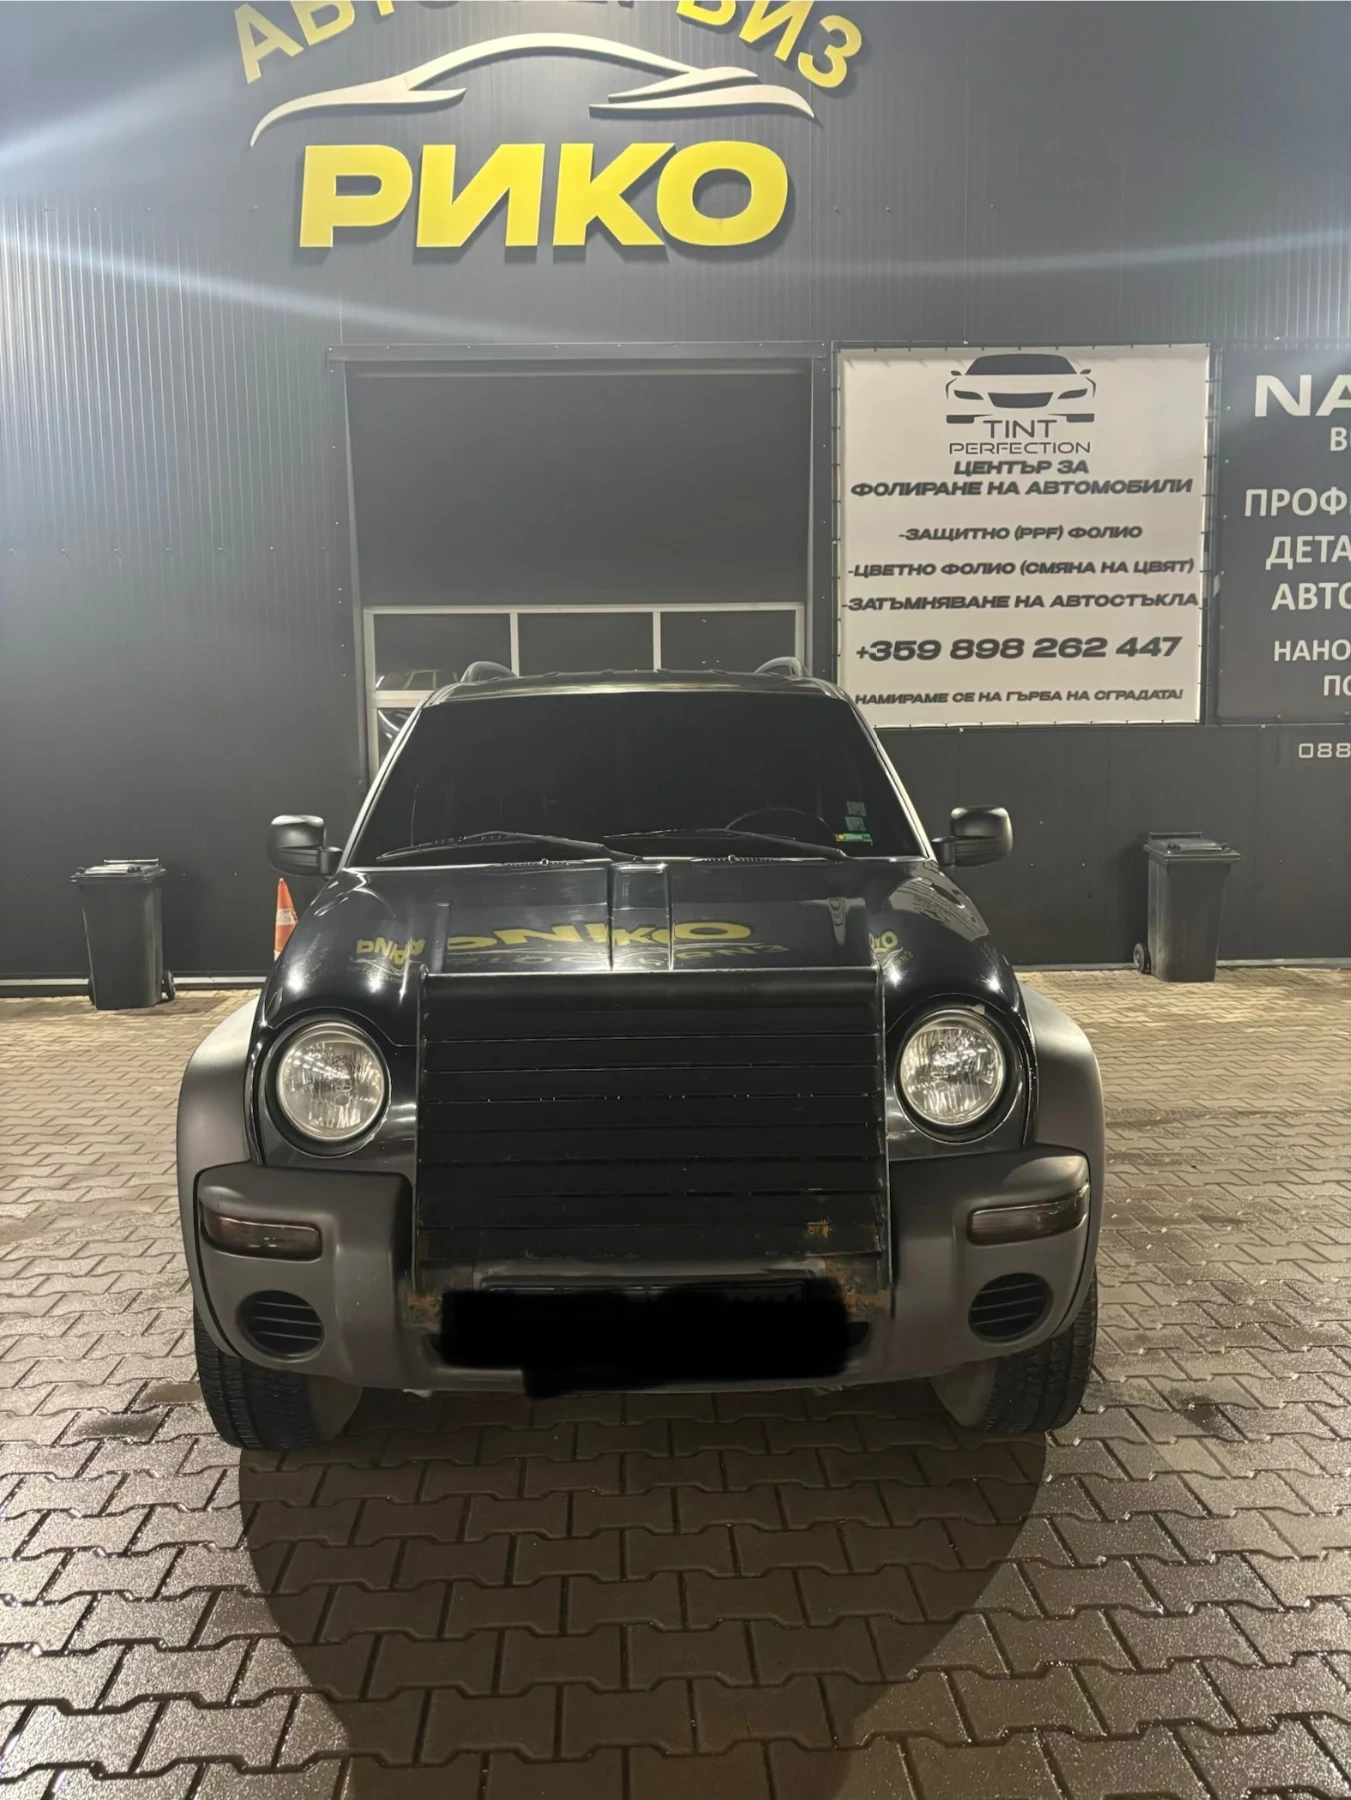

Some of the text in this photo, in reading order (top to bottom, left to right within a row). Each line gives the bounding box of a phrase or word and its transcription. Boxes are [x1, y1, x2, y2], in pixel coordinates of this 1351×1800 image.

[299, 140, 788, 248] РИКО
[982, 419, 1058, 439] TINT
[949, 441, 1091, 455] PERFECTION
[953, 459, 1089, 477] ЦЕНТЪР ЗА
[850, 478, 1194, 497] ФОЛИРАНЕ НА АВТОМОБИЛИ
[1244, 486, 1351, 517] ПРОФ
[898, 524, 1143, 542] -ЗАЩИТНО (PPF) ФОЛИО
[847, 557, 1195, 579] -ЦВЕТНО ФОЛИО (СМЯНА НА ЦВЯТ)
[1014, 595, 1045, 609] НА
[1049, 593, 1201, 610] АВТОСТЪКЛА
[856, 636, 1183, 662] +359 898 262 447
[854, 688, 1184, 706] НАМИРАМЕ СЕ НА ГЪРБА НА СГРАДАТА!
